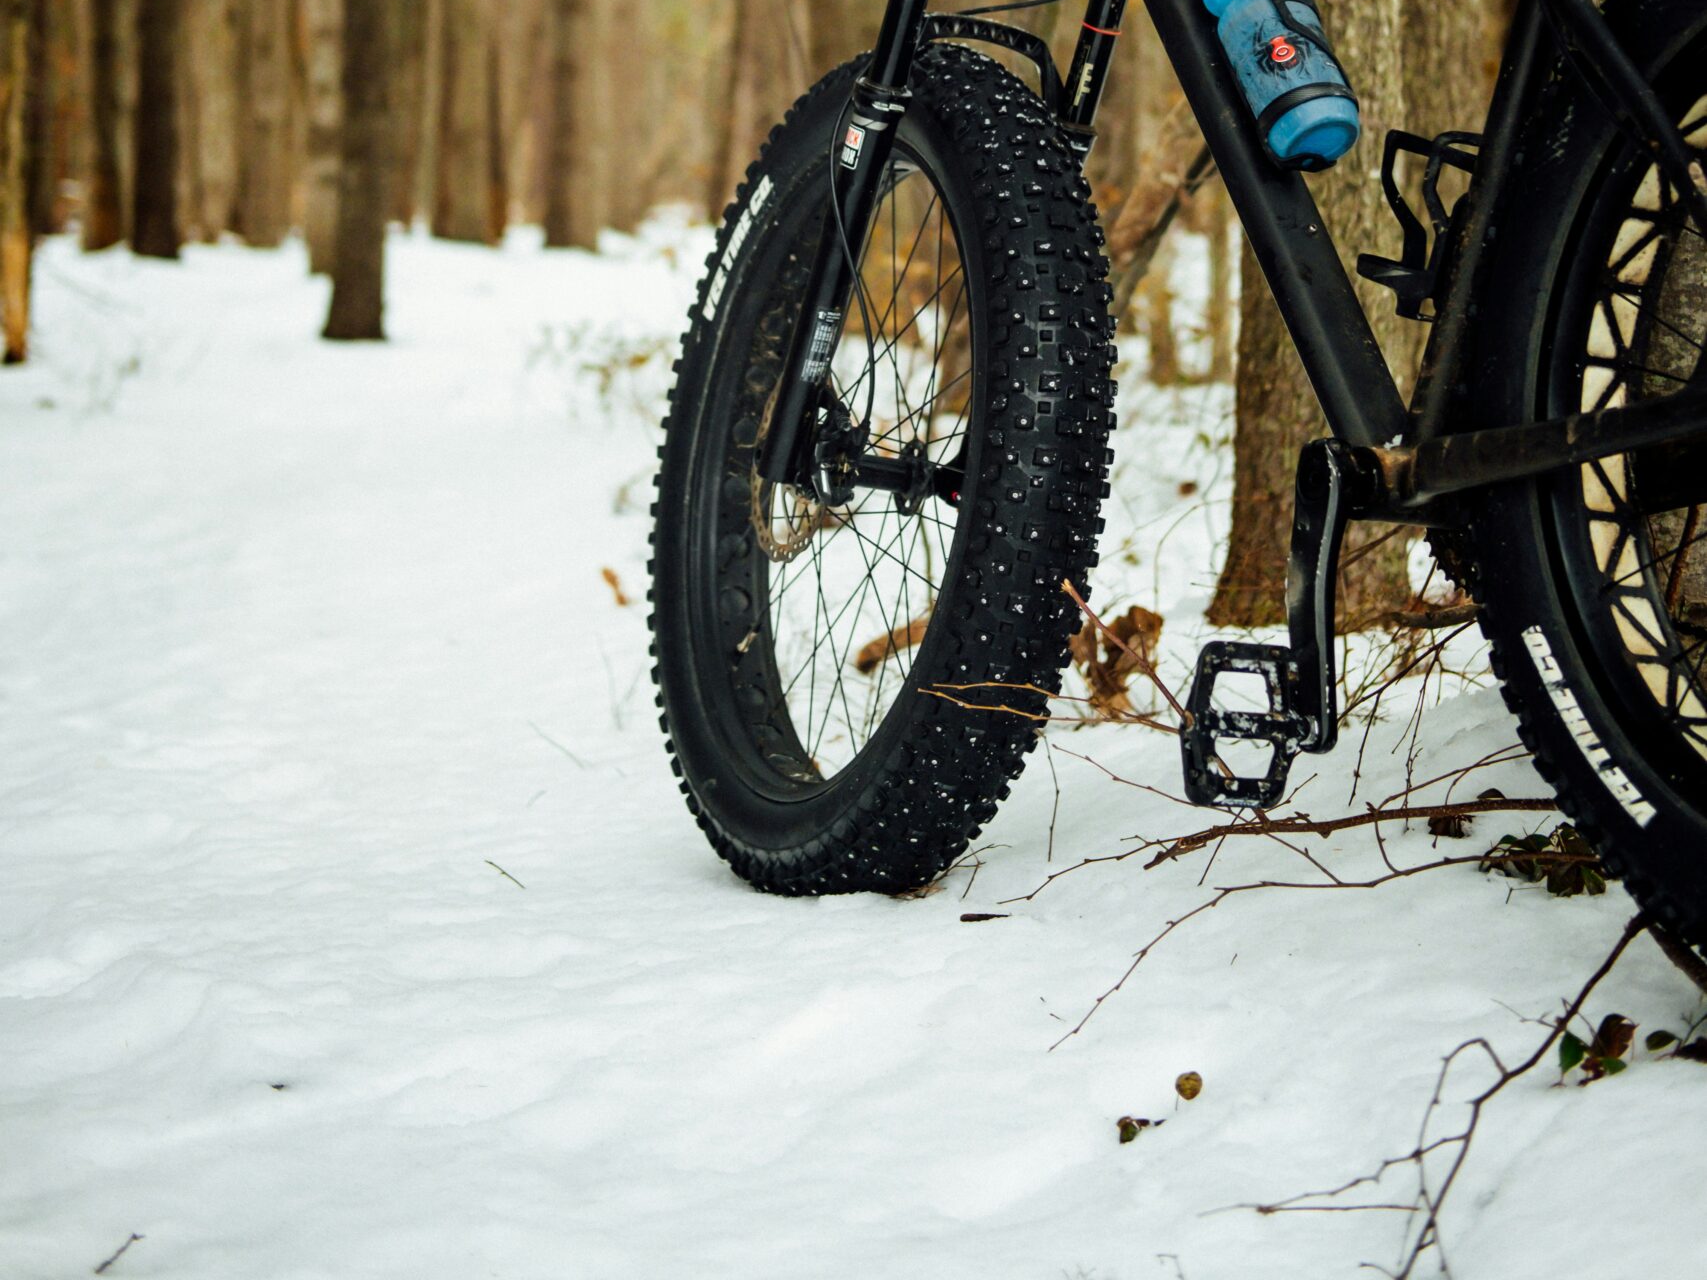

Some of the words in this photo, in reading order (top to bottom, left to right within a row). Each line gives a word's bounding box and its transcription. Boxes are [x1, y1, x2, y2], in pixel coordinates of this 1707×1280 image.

[702, 265, 728, 322] VEE
[721, 207, 752, 272] TIRE
[1549, 682, 1613, 771] TIRE
[1599, 766, 1658, 830] VEE
